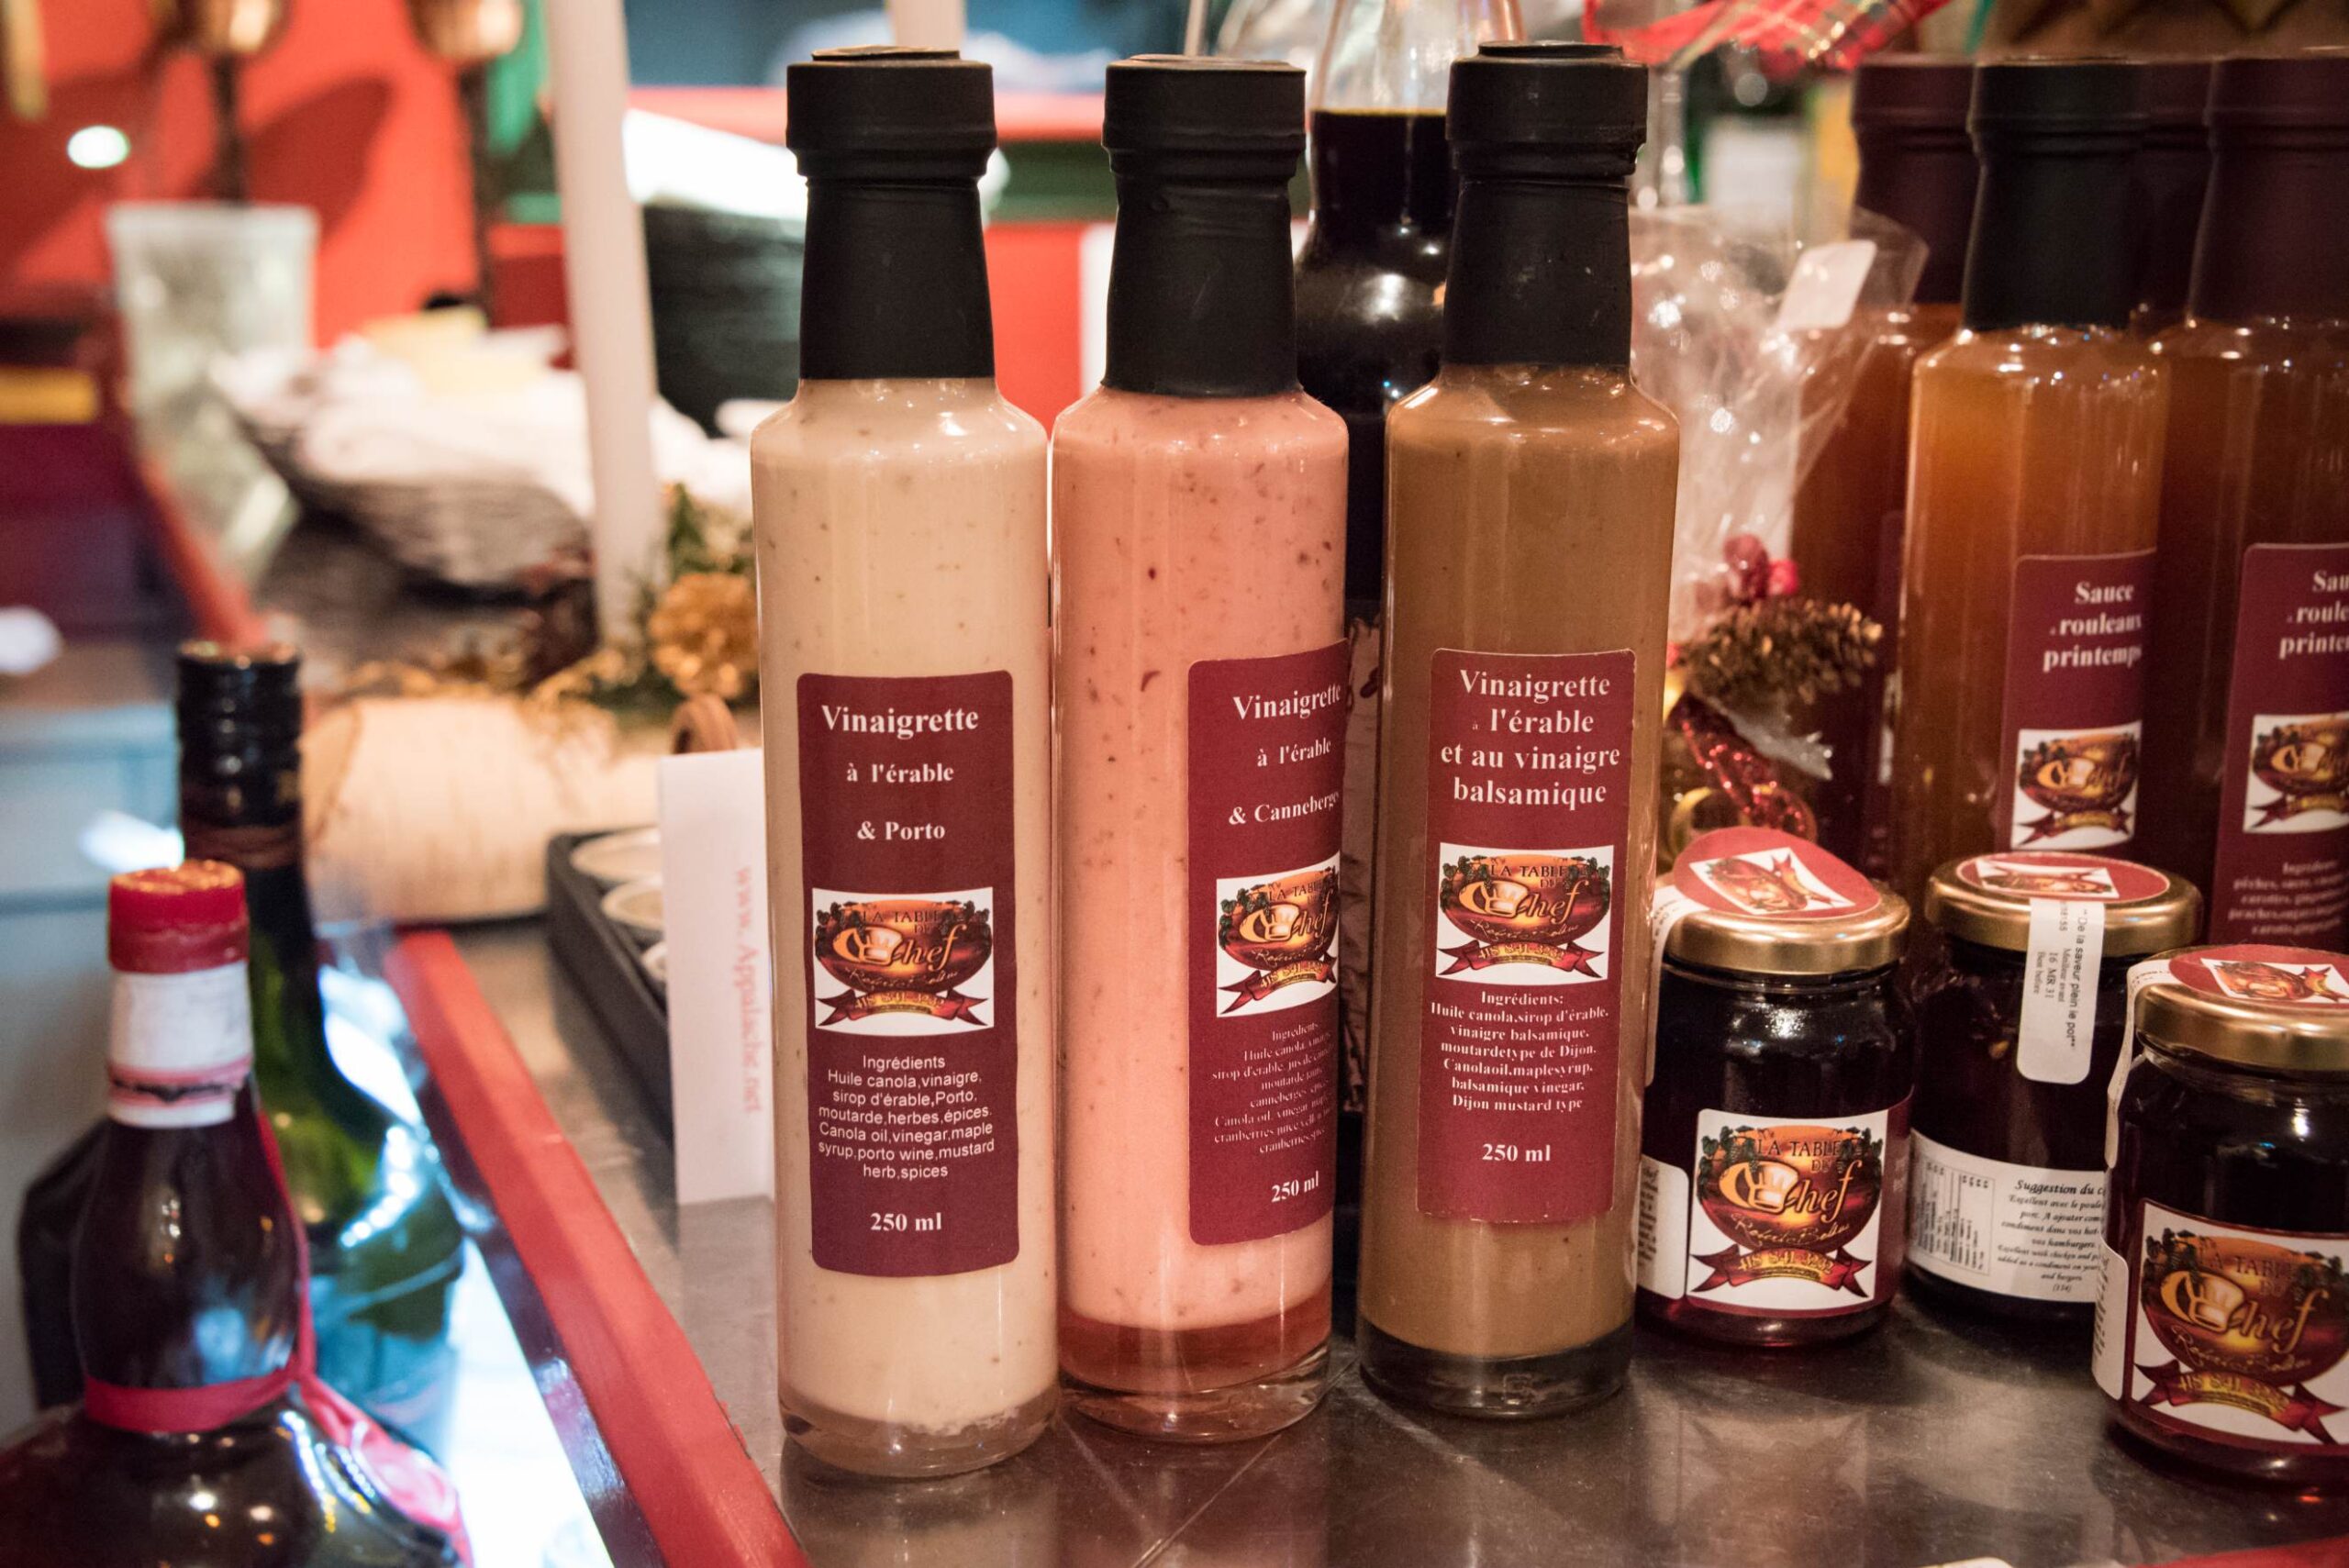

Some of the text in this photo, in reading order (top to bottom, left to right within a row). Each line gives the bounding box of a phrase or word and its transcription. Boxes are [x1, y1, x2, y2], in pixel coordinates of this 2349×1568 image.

[2075, 581, 2134, 605] Sauce
[1460, 669, 1610, 704] Vinaigrette
[1232, 683, 1341, 720] Vinaigrette
[821, 705, 979, 740] Vinaigrette
[1490, 708, 1595, 734] l'érable
[1257, 737, 1331, 767] à l'érable
[1441, 743, 1620, 775] et au vinaigre
[846, 762, 954, 783] à l'érable
[1453, 776, 1607, 811] balsamique
[1229, 806, 1246, 825] &
[857, 820, 946, 840] & Porto
[1459, 879, 1589, 924] Chef
[832, 924, 967, 972] Chef
[2072, 947, 2085, 982] saveur
[1431, 1001, 1465, 1019] Huile
[1451, 1024, 1506, 1041] vinaigre
[1540, 1046, 1555, 1059] de
[863, 1054, 946, 1073] Ingrédients
[828, 1069, 863, 1086] Huile
[1452, 1076, 1530, 1096] balsamique
[832, 1090, 866, 1107] sirop
[1453, 1095, 1583, 1113] Dijon mustard type
[819, 1122, 866, 1141] Canola
[1481, 1143, 1551, 1162] 250 ml
[1271, 1170, 1319, 1203] 250 ml
[1719, 1160, 1863, 1223] Chef
[2014, 1180, 2076, 1195] Suggestion
[2079, 1183, 2095, 1195] du
[870, 1212, 942, 1231] 250 ml
